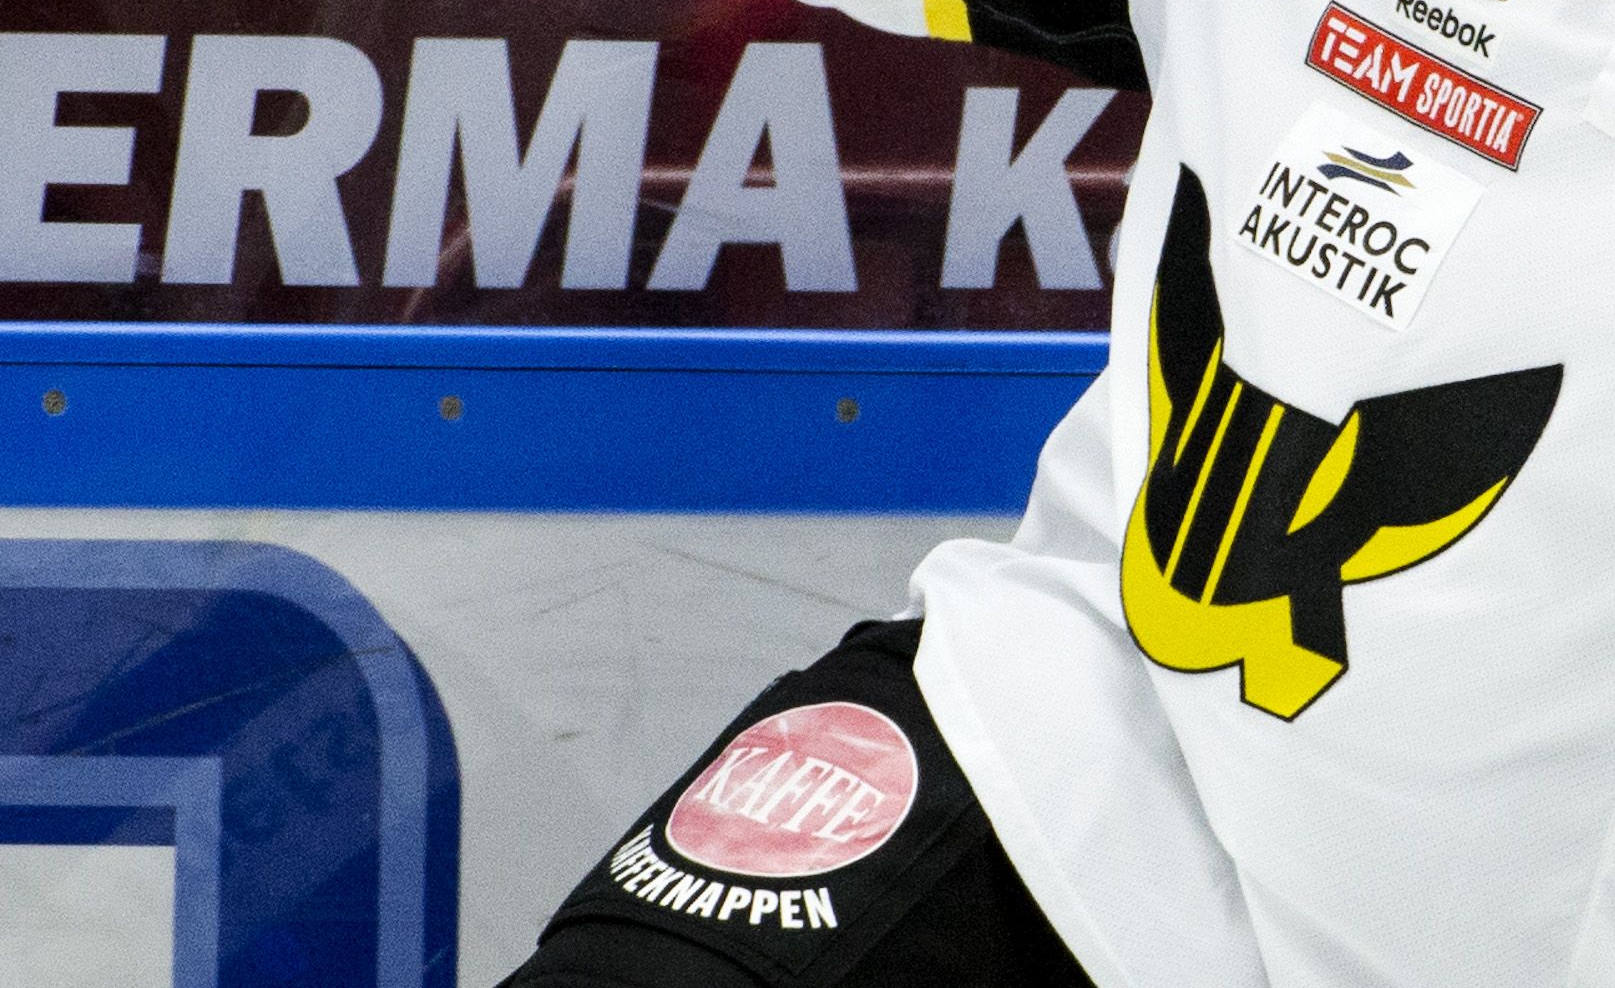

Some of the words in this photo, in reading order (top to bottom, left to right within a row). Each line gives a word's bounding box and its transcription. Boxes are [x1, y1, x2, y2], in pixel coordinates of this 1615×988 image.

[1321, 16, 1419, 102] TEAM
[1416, 72, 1518, 154] SPORTIA
[940, 85, 1134, 291] K
[1258, 161, 1431, 276] INTEROC
[1239, 203, 1408, 319] AKUSTIK
[692, 746, 886, 843] KAFFE
